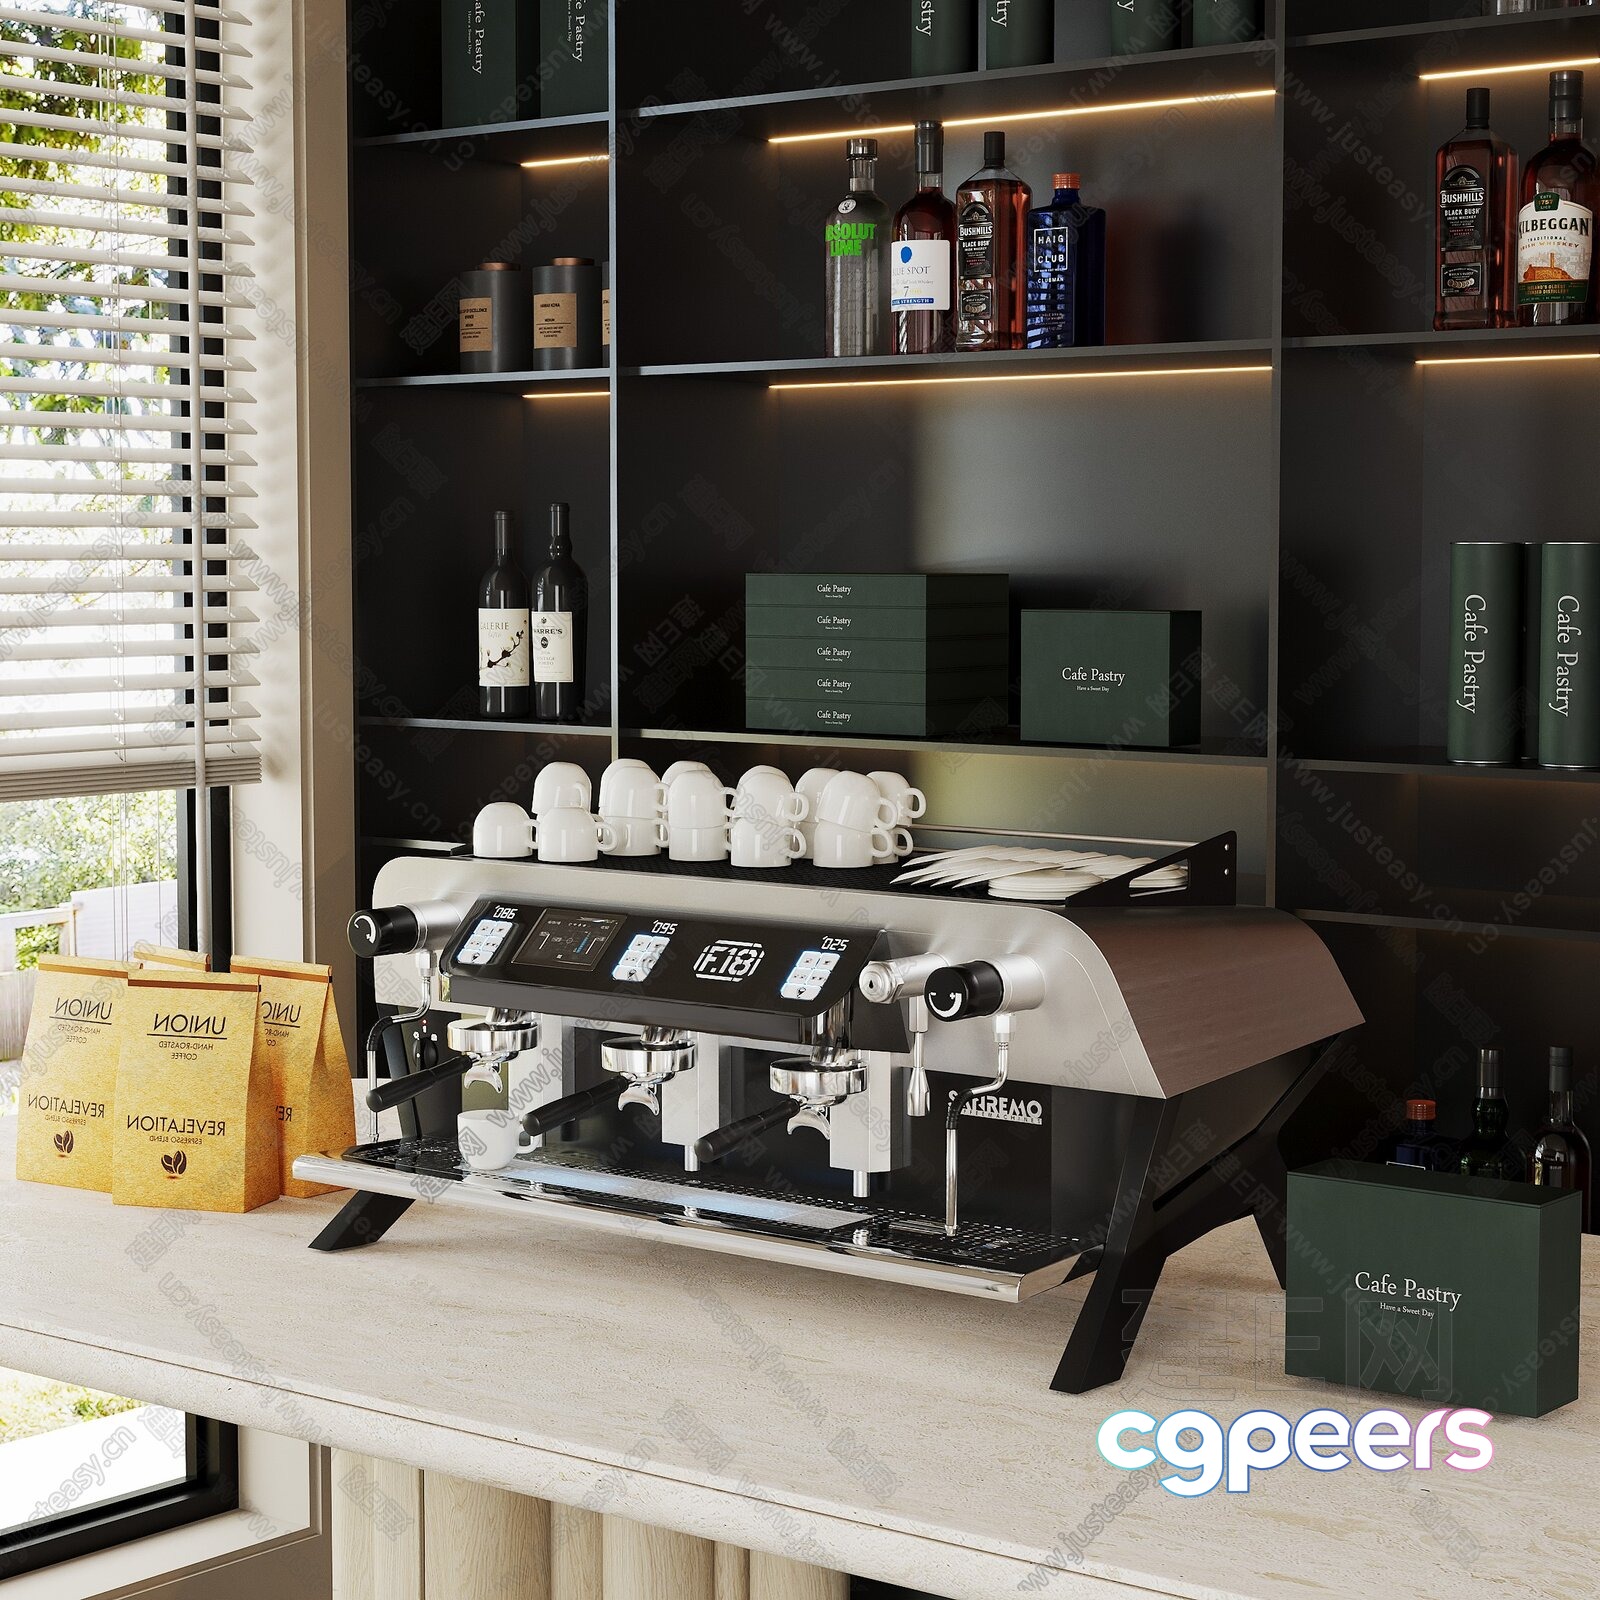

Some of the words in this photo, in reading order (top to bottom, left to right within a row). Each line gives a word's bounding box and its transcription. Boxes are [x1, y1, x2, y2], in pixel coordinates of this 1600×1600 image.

[474, 0, 486, 24] afe
[915, 0, 936, 37] stry
[990, 0, 1009, 28] try
[571, 14, 586, 63] Pastry
[471, 28, 485, 75] Pastry
[1441, 192, 1484, 204] BUSHMILLS
[1444, 208, 1463, 217] BLACK
[1464, 207, 1480, 215] BUSH
[825, 223, 876, 242] BSOLUT
[959, 226, 993, 237] BUSHMILLS
[1037, 234, 1064, 245] HAIG
[829, 239, 863, 257] LIME
[1037, 254, 1065, 264] CLUB
[906, 265, 930, 275] SPOT
[903, 286, 909, 298] 7
[816, 584, 831, 593] Cafe
[832, 584, 852, 595] Pastry
[816, 615, 831, 624] Cafe
[832, 616, 852, 626] Pastry
[1464, 594, 1489, 642] Cafe
[1557, 595, 1582, 643] Cafe
[816, 647, 831, 656] Cafe
[832, 647, 852, 658] Pastry
[816, 678, 831, 688] Cafe
[832, 679, 852, 690] Pastry
[1062, 666, 1088, 681] Cafe
[1090, 668, 1126, 687] Pastry
[1456, 649, 1485, 714] Pastry
[1548, 651, 1579, 717] Pastry
[816, 710, 831, 719] Cafe
[832, 710, 852, 721] Pastry
[1355, 1271, 1397, 1295] Cafe
[1403, 1278, 1462, 1312] Pastry
[1380, 1302, 1396, 1312] Have
[1402, 1305, 1421, 1315] Sweet
[1421, 1309, 1435, 1319] Day
